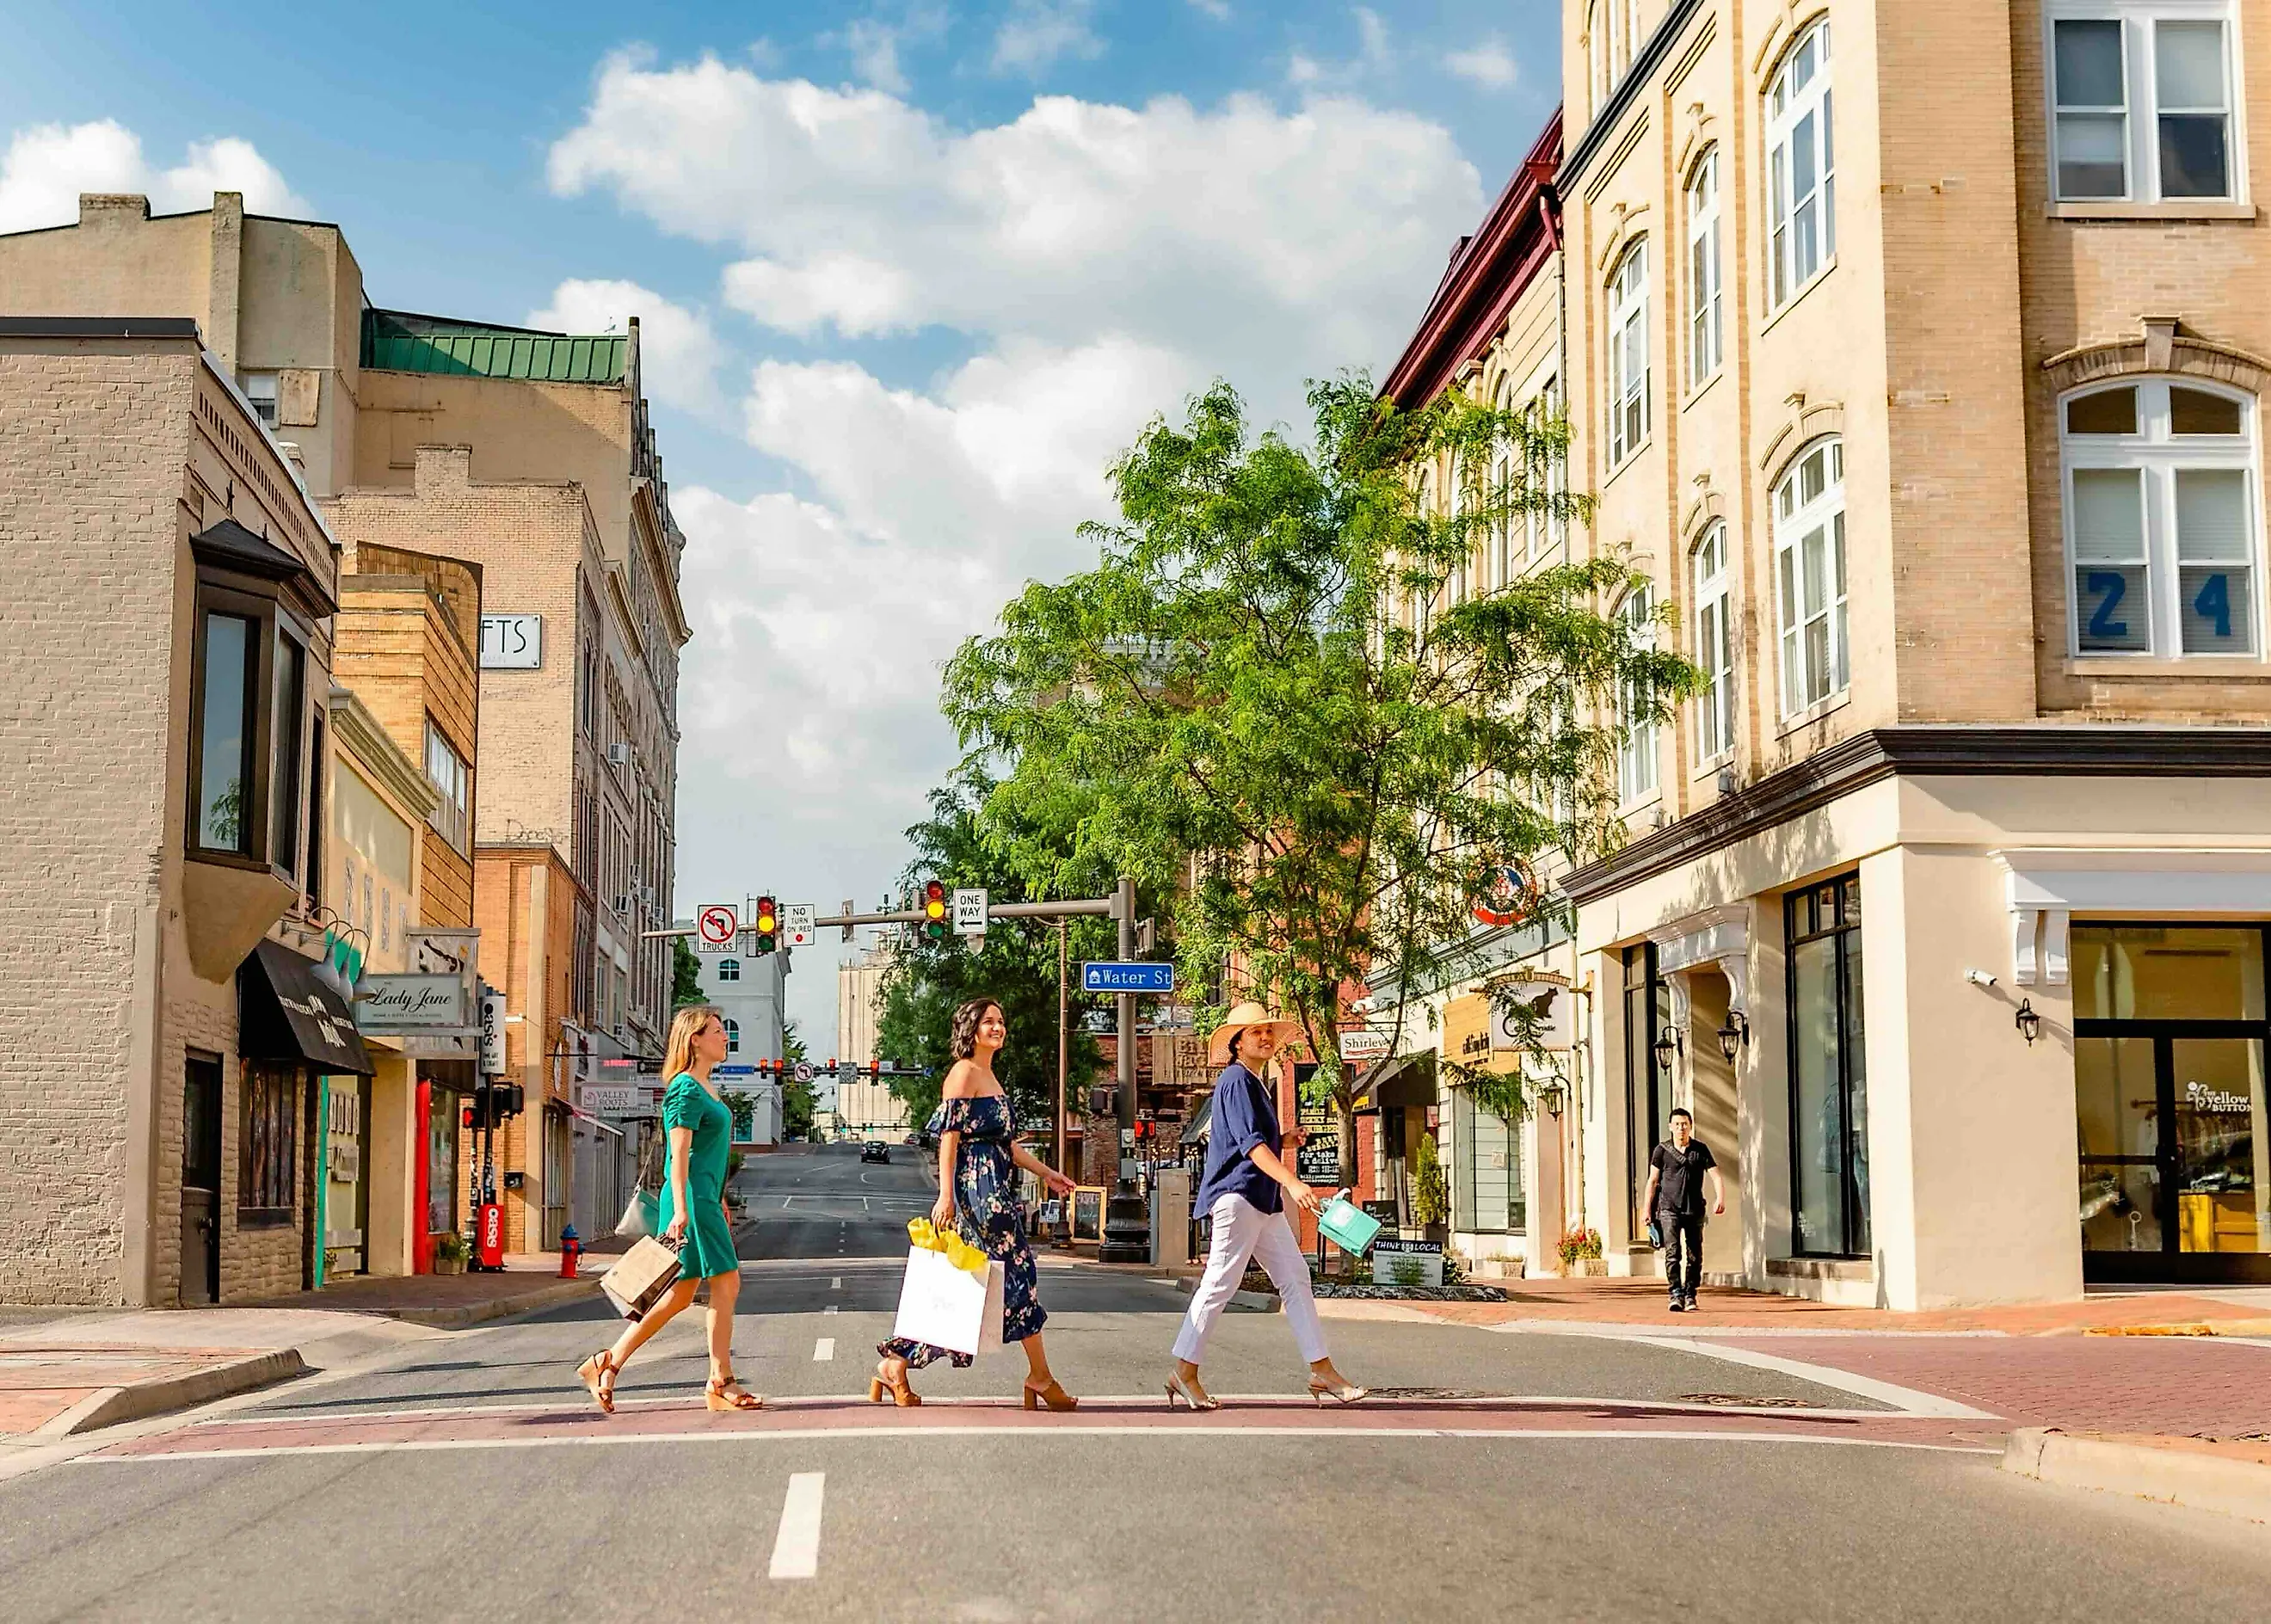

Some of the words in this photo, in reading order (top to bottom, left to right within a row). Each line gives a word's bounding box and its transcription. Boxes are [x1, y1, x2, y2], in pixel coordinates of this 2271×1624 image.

[2088, 572, 2127, 636] 2
[2194, 574, 2231, 636] 4
[481, 619, 526, 654] FTS
[960, 895, 982, 905] ONE
[792, 907, 806, 916] NO
[959, 907, 981, 917] WAY
[702, 942, 733, 951] TRUCKS
[1102, 969, 1147, 984] Water
[1154, 969, 1172, 985] St
[366, 987, 412, 1012] Lady
[409, 987, 452, 1013] Jane
[483, 1002, 498, 1047] oasis
[2206, 1091, 2249, 1109] yellow
[1316, 1150, 1336, 1159] take
[1376, 1241, 1400, 1250] THINK
[1414, 1243, 1441, 1252] LOCAL
